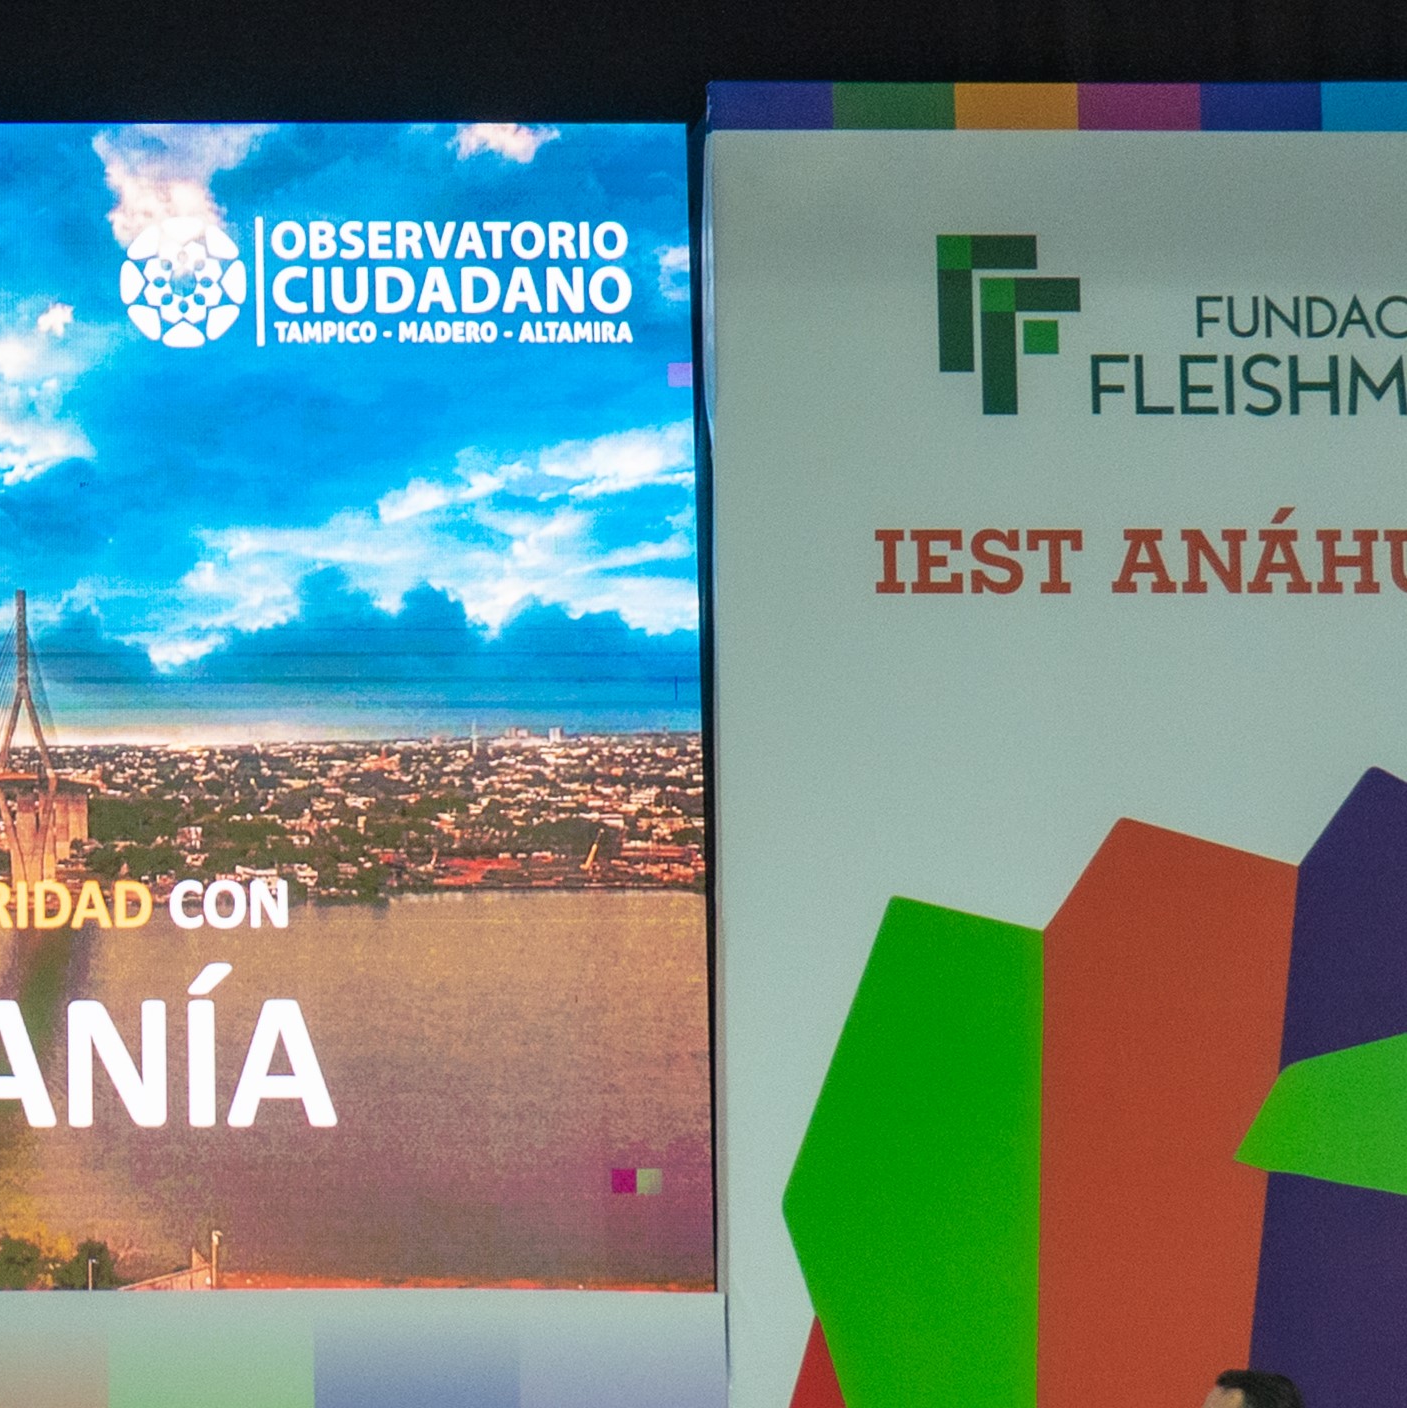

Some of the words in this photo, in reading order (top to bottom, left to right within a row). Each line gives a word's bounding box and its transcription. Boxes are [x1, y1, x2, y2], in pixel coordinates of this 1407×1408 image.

[271, 221, 628, 259] OBSERVATORIO
[273, 266, 631, 314] CIUDADANO
[274, 321, 377, 343] TAMPICO
[399, 321, 497, 343] MADERO
[519, 322, 632, 342] ALTAMIRA
[1195, 295, 1407, 340] FUNDAC
[1090, 353, 1407, 417] FLEISHM
[874, 528, 1083, 595] IEST
[169, 880, 289, 929] CON
